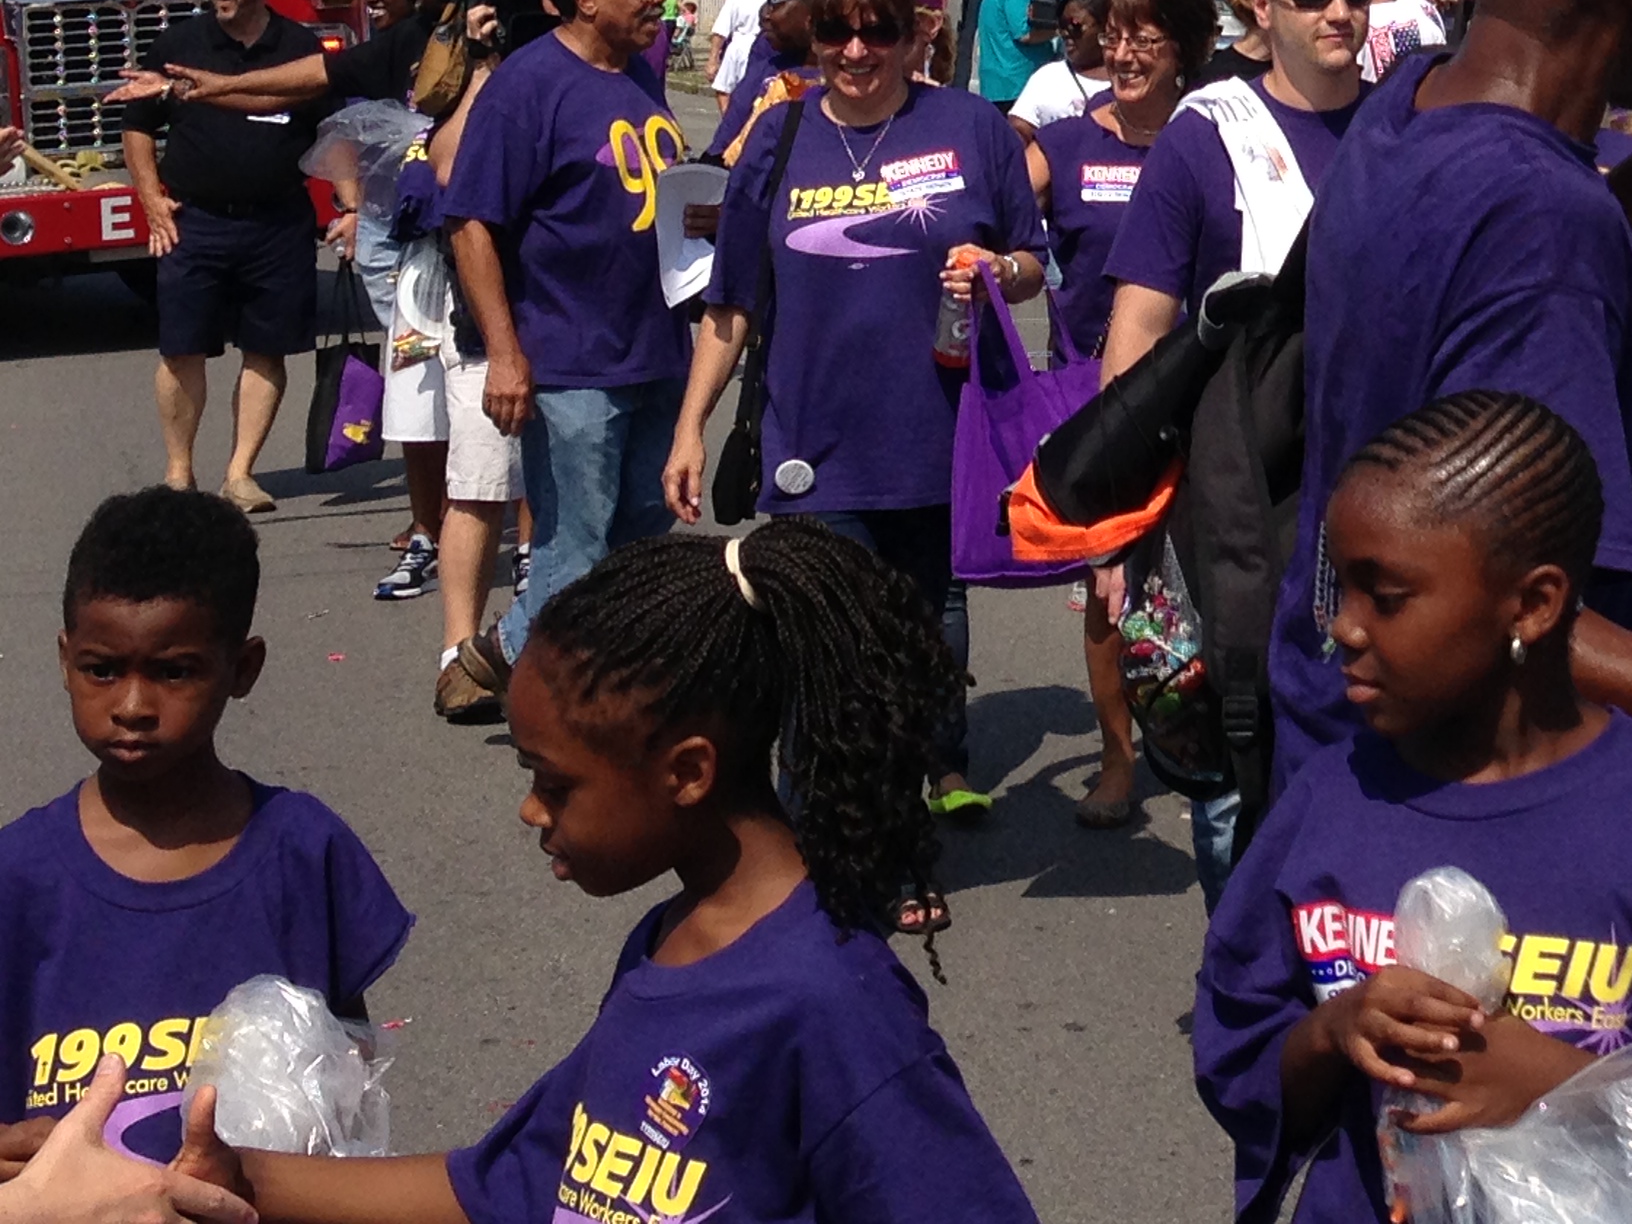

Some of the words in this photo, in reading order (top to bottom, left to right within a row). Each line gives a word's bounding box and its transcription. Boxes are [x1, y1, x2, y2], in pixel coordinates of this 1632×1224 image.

[880, 150, 955, 182] KENNEDY
[100, 195, 136, 241] E
[651, 1057, 681, 1077] Labor
[681, 1058, 701, 1081] Day
[698, 1078, 709, 1116] 2014
